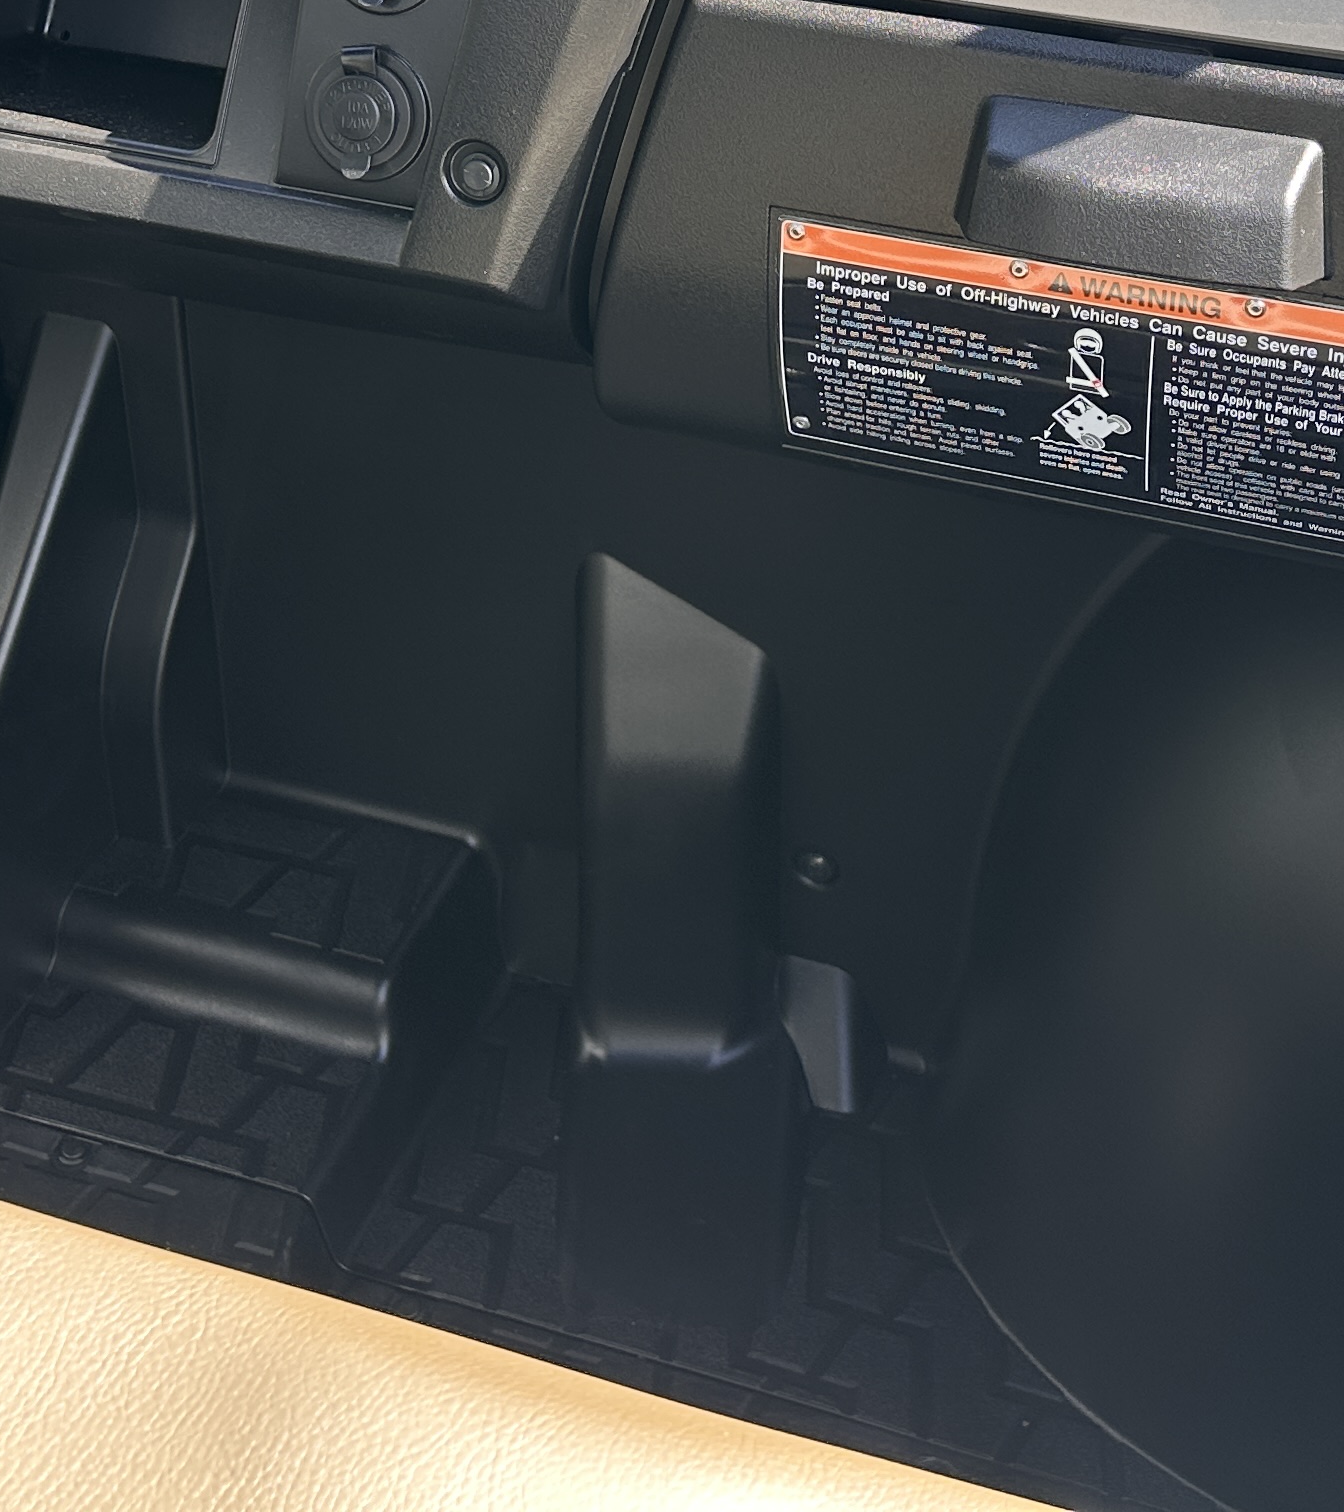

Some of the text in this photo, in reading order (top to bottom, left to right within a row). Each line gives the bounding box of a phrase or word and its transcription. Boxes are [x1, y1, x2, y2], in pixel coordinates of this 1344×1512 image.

[806, 276, 890, 302] Be Prepared
[1079, 275, 1221, 319] WARNING
[816, 260, 887, 285] Improper
[896, 274, 926, 292] Use
[935, 283, 952, 296] of
[960, 286, 1060, 318] Off-Highway
[1069, 304, 1139, 329] Vehicles
[1148, 318, 1182, 336] Can
[1192, 325, 1247, 347] Cause
[1257, 335, 1317, 358] Severe
[807, 351, 926, 384] Drive Responsibly
[1166, 338, 1183, 352] Be
[1188, 342, 1217, 358] Sure
[1222, 348, 1286, 370] Occupants
[1293, 359, 1315, 377] Pay
[1163, 381, 1178, 397] Be
[1180, 384, 1206, 401] Sure
[1207, 390, 1219, 402] to
[1220, 392, 1253, 410] Apply
[1254, 398, 1272, 412] the
[1274, 401, 1317, 422] Parking
[1163, 394, 1210, 413] Require
[1216, 403, 1258, 421] Proper
[1264, 412, 1289, 427] Use
[1294, 419, 1308, 431] of
[1314, 421, 1343, 436] Your
[1160, 487, 1279, 516] Read Owner's Manual.
[1160, 494, 1193, 507] Follow
[1198, 502, 1212, 510] All
[1217, 505, 1278, 523] Instructions
[1282, 519, 1303, 528] and
